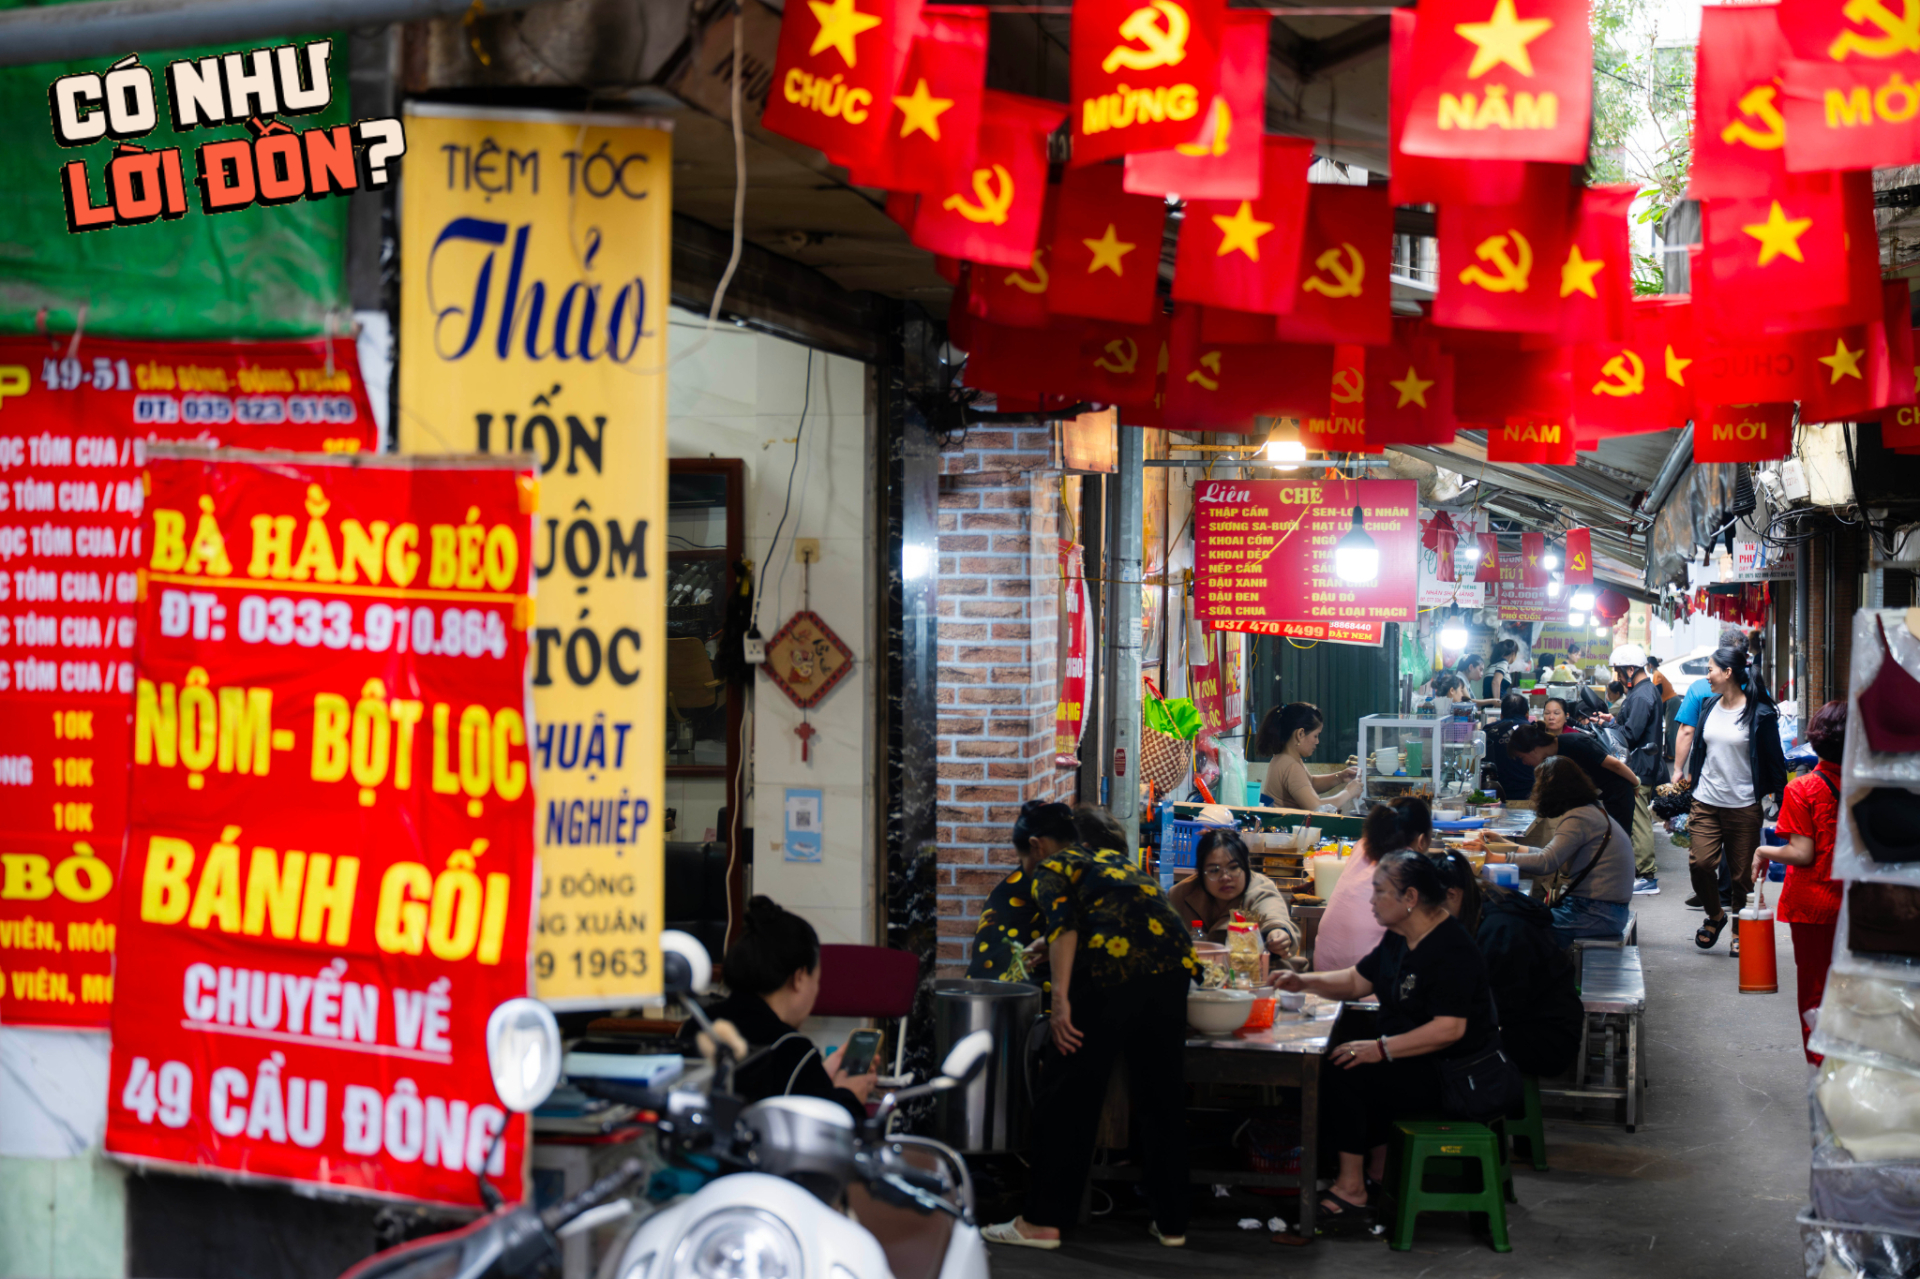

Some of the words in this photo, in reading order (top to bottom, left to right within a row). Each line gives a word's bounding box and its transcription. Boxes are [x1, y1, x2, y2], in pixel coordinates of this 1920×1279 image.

[784, 67, 873, 125] CHÚC
[1082, 83, 1199, 135] MỪNG
[1437, 83, 1559, 130] NĂM
[1824, 73, 1920, 129] MỚ
[440, 136, 540, 204] TIỆM
[560, 140, 648, 200] TÓC
[427, 216, 655, 364] Thảo
[1503, 422, 1561, 444] NĂM
[1712, 417, 1768, 441] MỚI
[28, 431, 72, 467] TÔM
[75, 436, 118, 467] CUA
[13, 476, 55, 512] TÔM
[58, 481, 100, 512] CUA
[1199, 482, 1252, 503] Liên
[1280, 481, 1324, 504] CHÈ
[1208, 521, 1249, 531] SƯƠNG
[1209, 506, 1239, 519] THẬP
[1312, 507, 1372, 517] SEN-LOG
[1312, 522, 1335, 533] HẠT
[30, 521, 73, 557] TÔM
[75, 526, 117, 557] CUA
[428, 505, 518, 591] BÉO
[1208, 536, 1244, 545] KHOAI
[1246, 533, 1274, 545] CỐM
[1208, 550, 1244, 559] KHOAI
[1312, 534, 1337, 545] NGÔ
[1207, 576, 1233, 590] ĐẬU
[1235, 578, 1268, 588] XANH
[1208, 561, 1233, 574] NẾP
[14, 565, 57, 602] TÔM
[60, 571, 102, 602] CUA
[1207, 590, 1233, 604] ĐẬU
[1234, 592, 1260, 602] ĐEN
[1311, 590, 1336, 604] ĐẬU
[1339, 590, 1355, 602] ĐỎ
[160, 589, 227, 641] ĐT:
[238, 594, 508, 660] 0333.910.864
[1208, 604, 1233, 616] SỮA
[1235, 606, 1266, 616] CHUA
[1312, 605, 1336, 616] CÁC
[1339, 607, 1366, 619] LOẠI
[1368, 607, 1408, 619] THẠCH
[14, 610, 57, 647] TÔM
[60, 616, 102, 647] CUA
[1214, 620, 1245, 630] 037
[1249, 622, 1280, 633] 470
[1284, 624, 1324, 637] 4499
[1351, 632, 1373, 641] NEM
[531, 606, 643, 688] TÓC
[14, 655, 57, 692] TÔM
[60, 661, 102, 692] CUA
[53, 710, 93, 740] 10K
[310, 677, 424, 807] BỘT
[431, 702, 528, 818] LỌC
[535, 710, 633, 783] HUẬT
[53, 757, 93, 787] 10K
[53, 802, 93, 832] 10K
[545, 787, 649, 858] NGHIỆP
[140, 824, 360, 946] BÁNH
[375, 837, 511, 965] GỐI
[575, 908, 646, 937] XUÂN
[568, 946, 648, 979] 1963
[183, 957, 379, 1044] CHUYỂN
[122, 1056, 194, 1129] 49
[209, 1050, 329, 1149] CẦU
[342, 1077, 508, 1177] ĐÔNG
